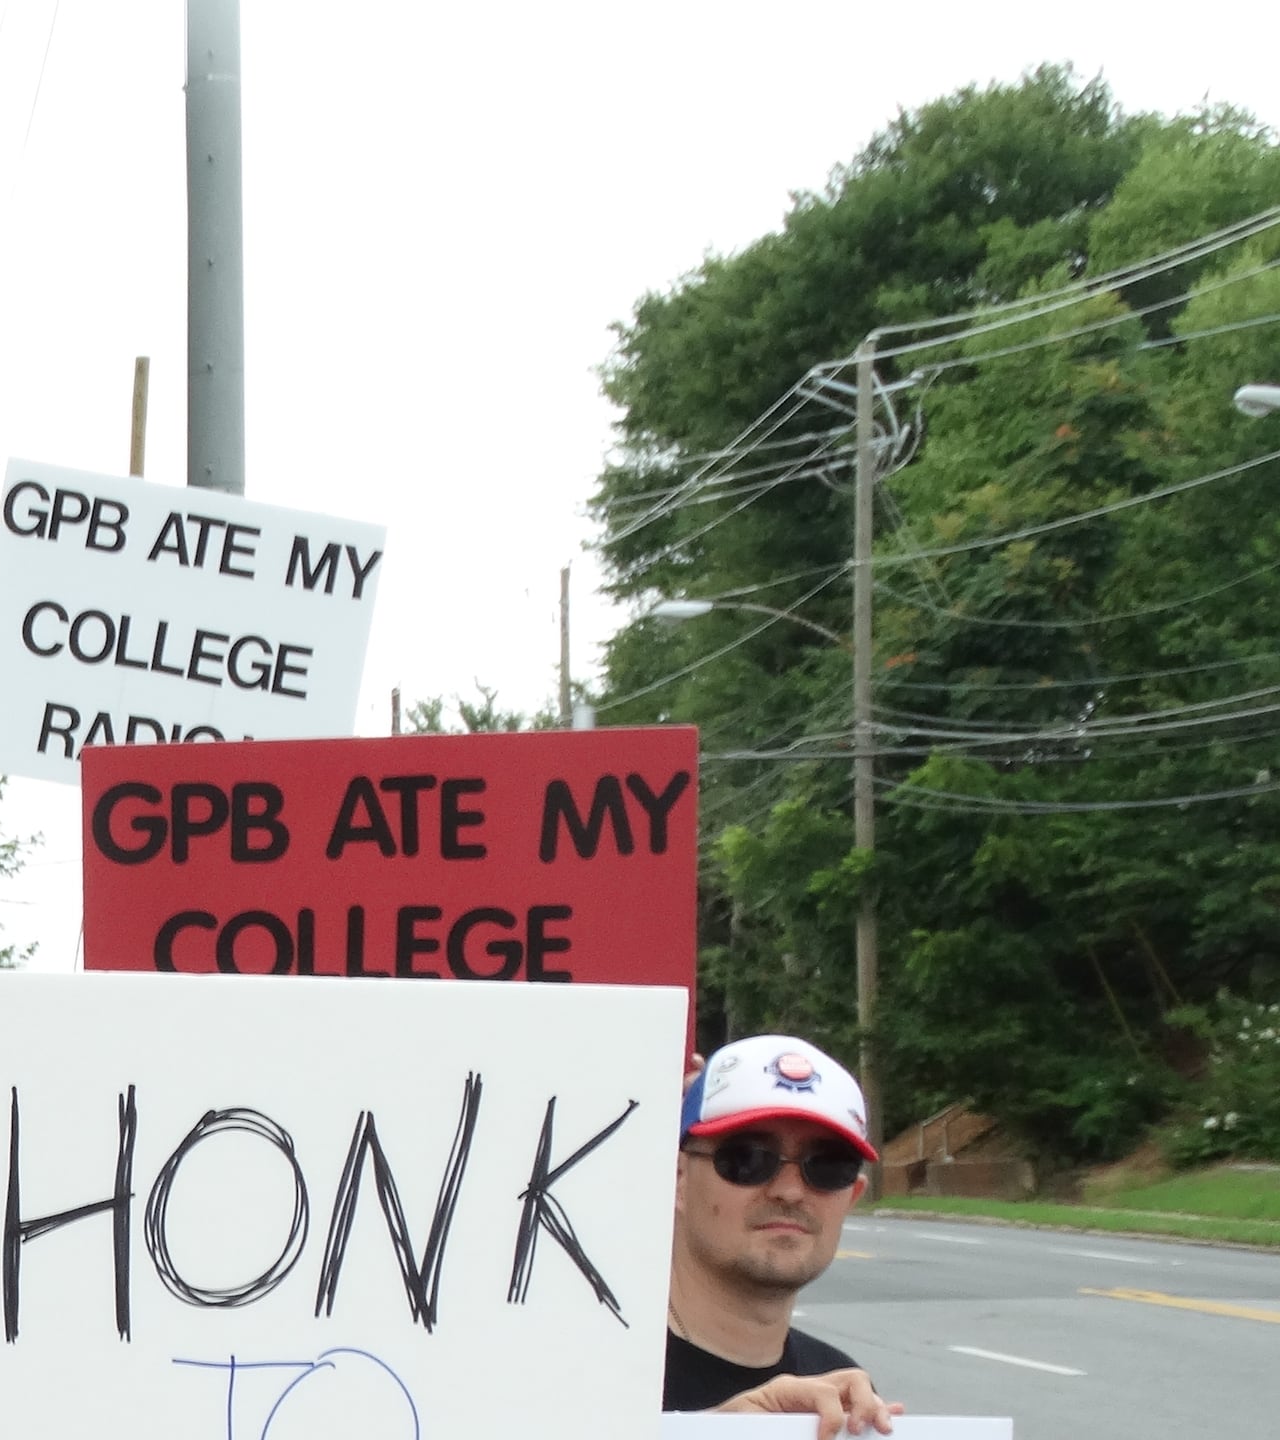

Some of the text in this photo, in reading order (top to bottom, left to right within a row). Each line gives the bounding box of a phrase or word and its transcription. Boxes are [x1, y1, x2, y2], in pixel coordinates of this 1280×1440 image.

[2, 481, 383, 600] GPB ATE MY
[21, 600, 313, 700] COLLEGE
[91, 770, 690, 866] GPB ATE MY
[154, 905, 573, 984] COLLEGE
[2, 1071, 640, 1344] HONK
